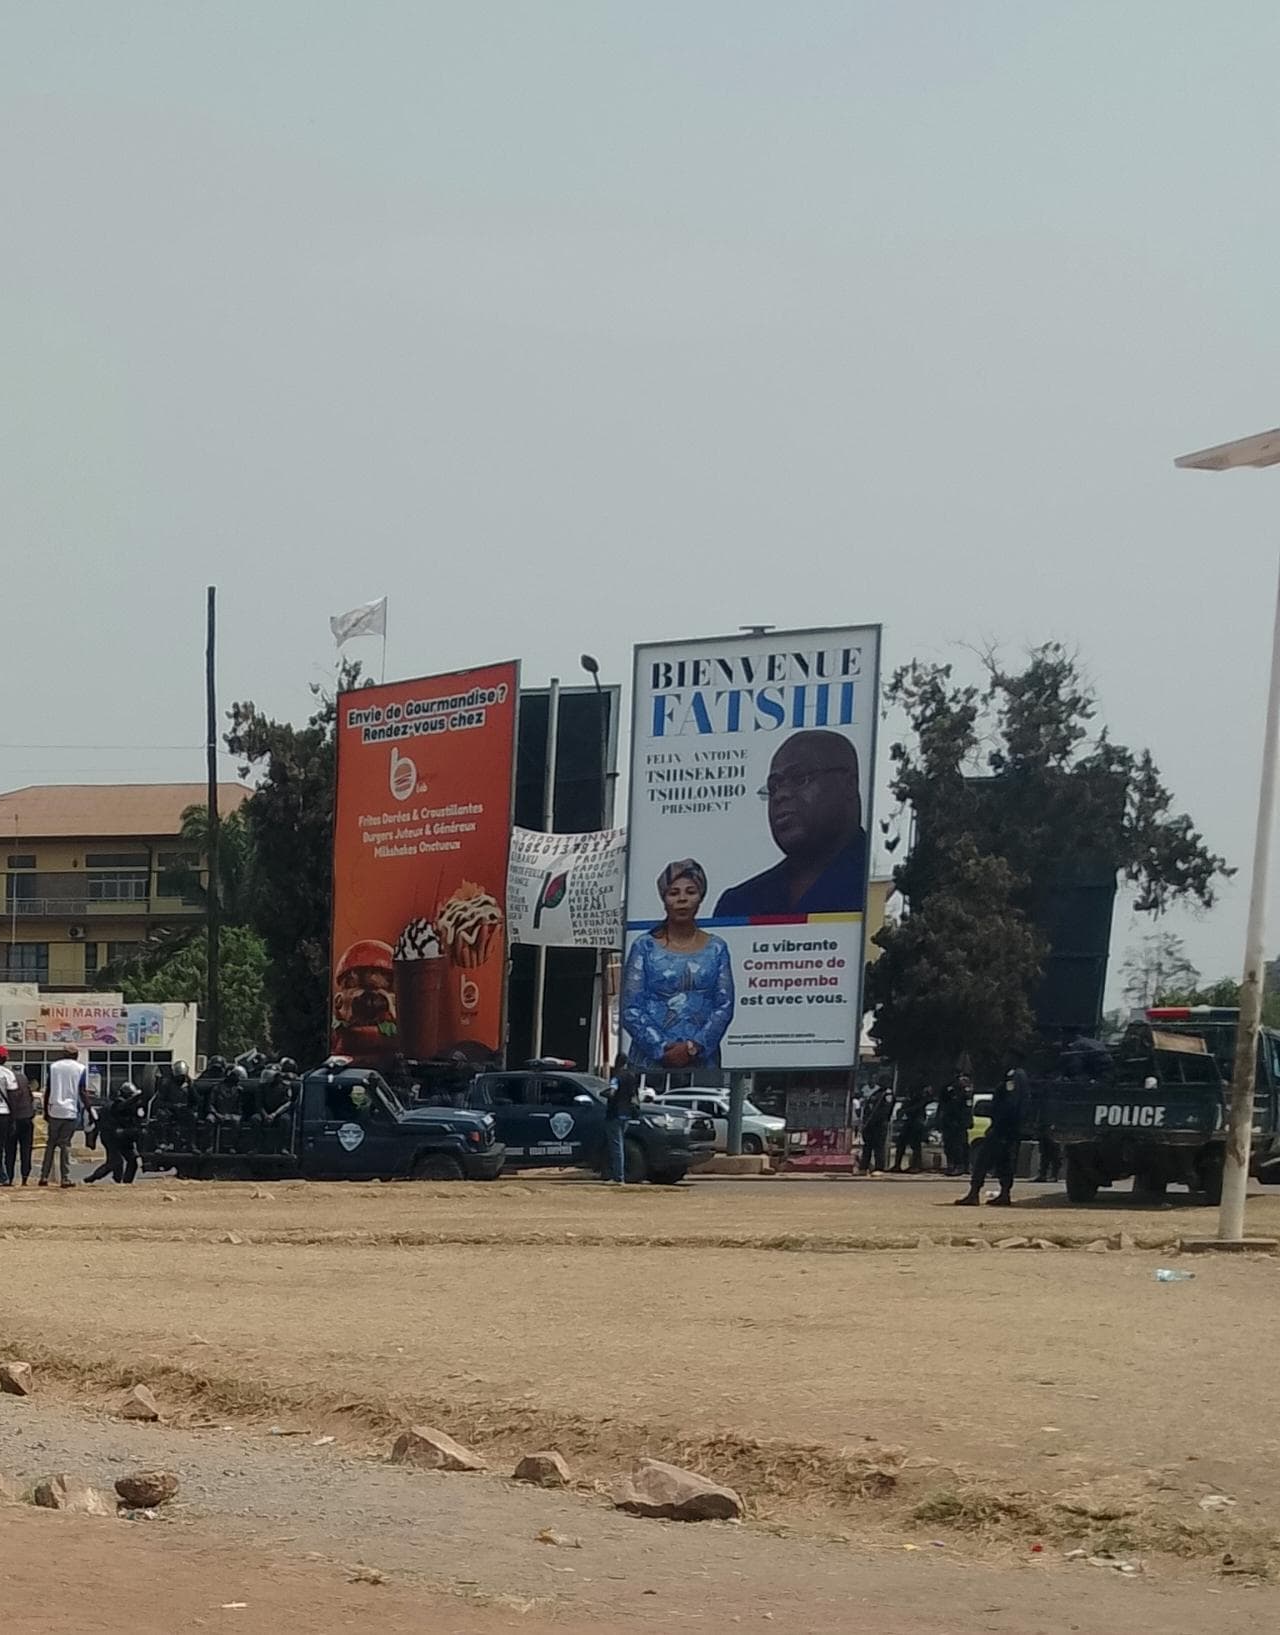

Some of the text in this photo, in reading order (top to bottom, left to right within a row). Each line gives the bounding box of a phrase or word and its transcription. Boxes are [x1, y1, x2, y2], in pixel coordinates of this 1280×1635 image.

[651, 648, 862, 689] BIENVENUE
[348, 709, 382, 726] Envie
[386, 705, 401, 720] de
[406, 689, 496, 716] Gourmandise
[647, 681, 861, 737] FATSHI
[363, 711, 484, 742] Rendez-vous chez
[693, 749, 749, 763] ANTOINE
[646, 765, 746, 784] TSHISEKEDI
[647, 784, 747, 802] TSHILOMBO
[661, 801, 732, 815] PRESIDENT
[753, 939, 838, 953] La vibrante
[743, 956, 846, 971] Commune de
[748, 974, 838, 991] Kampemba
[740, 993, 847, 1006] est avec vous.
[41, 1007, 69, 1018] MINI
[1094, 1105, 1166, 1127] POLICE
